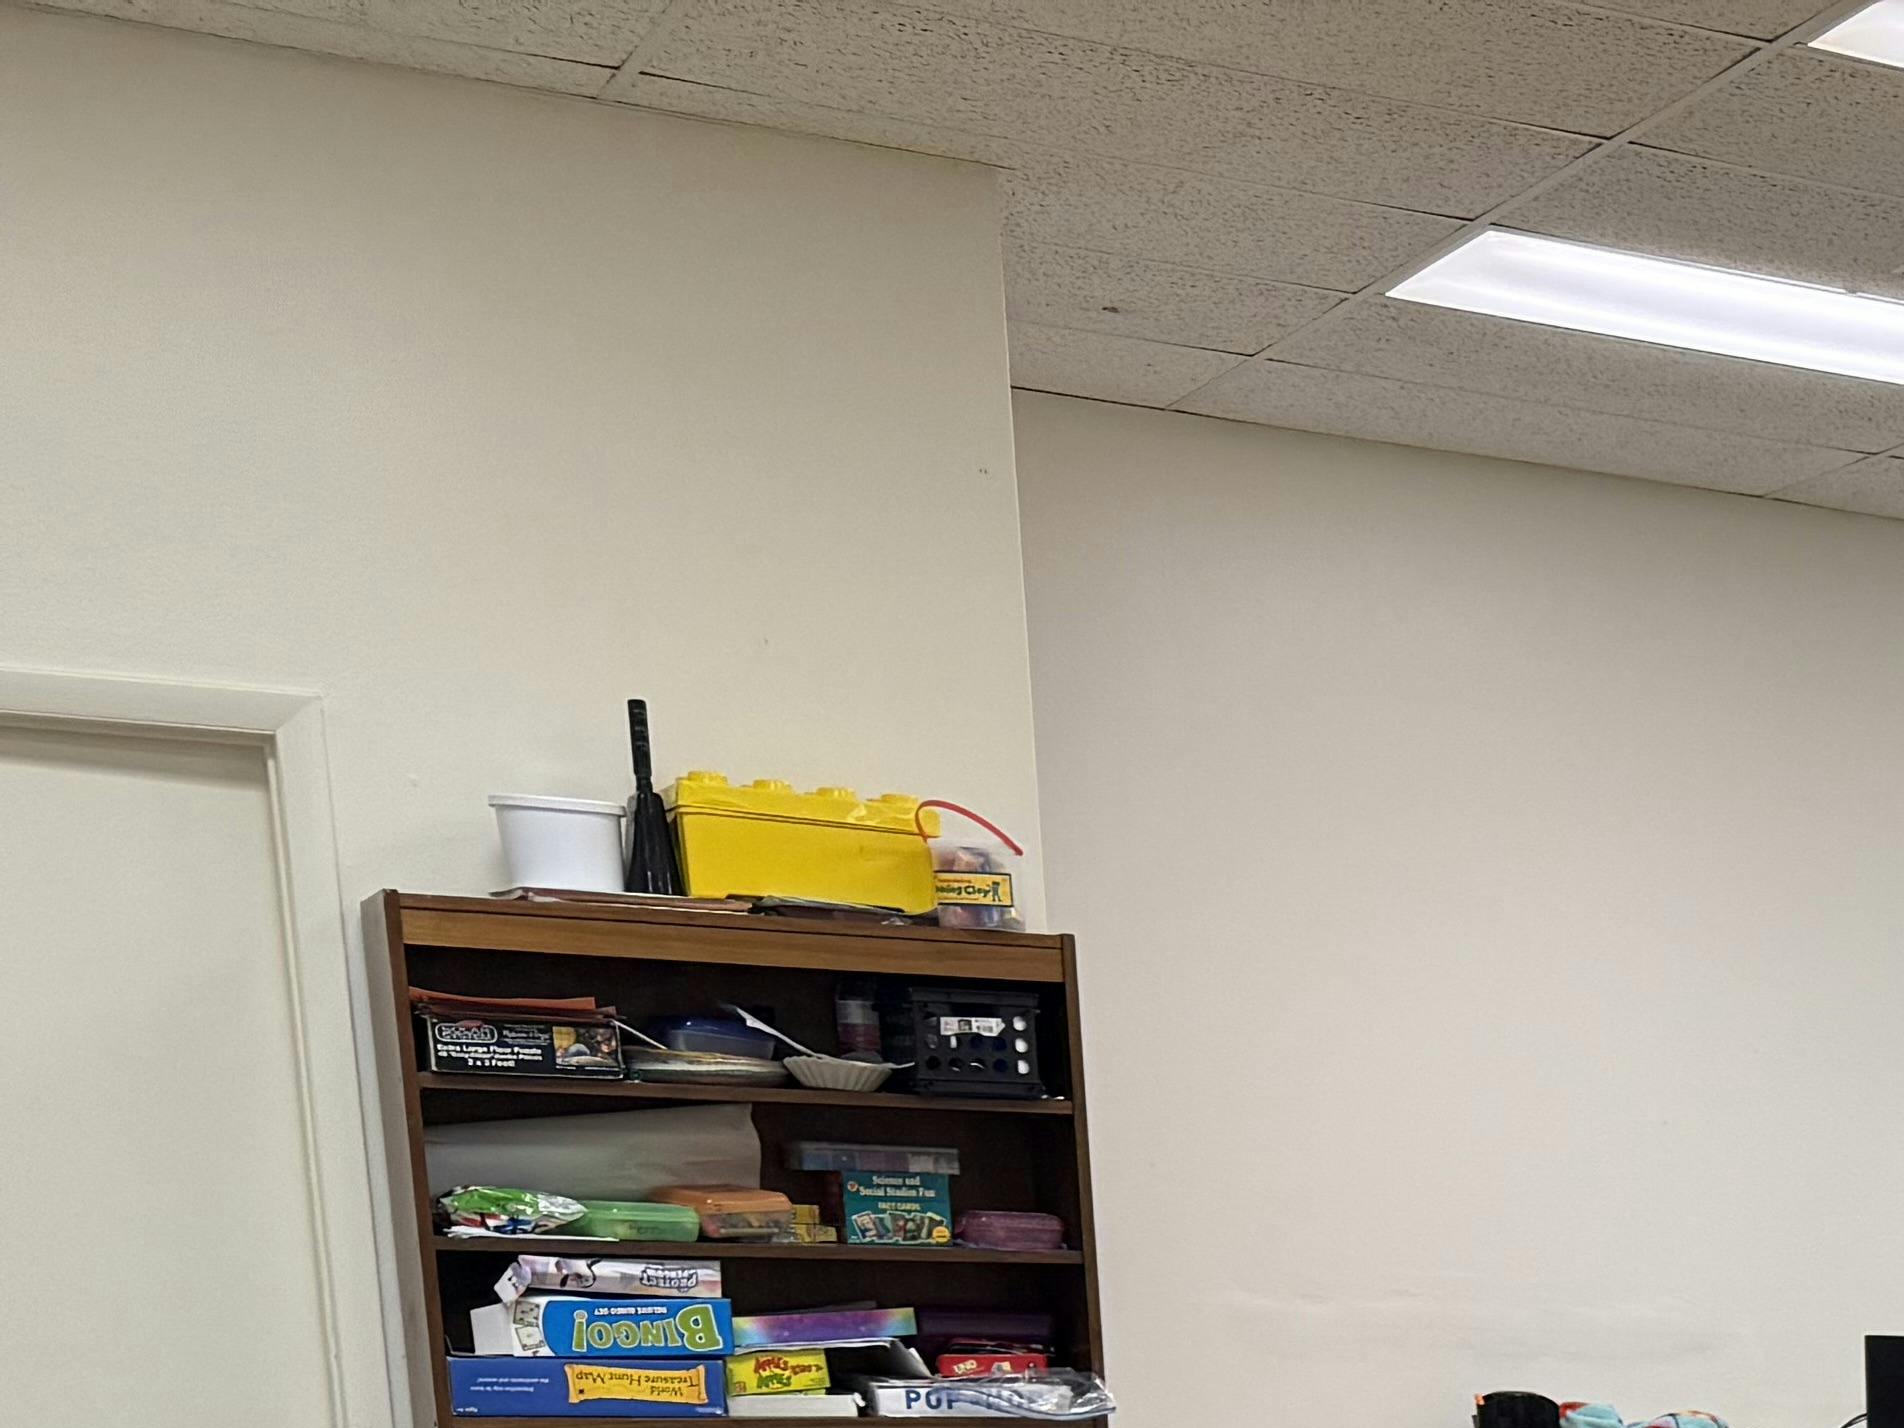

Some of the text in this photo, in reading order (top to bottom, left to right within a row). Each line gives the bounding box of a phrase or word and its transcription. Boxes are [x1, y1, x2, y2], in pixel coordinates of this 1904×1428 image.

[872, 1176, 920, 1186] Science and
[860, 1186, 936, 1198] Social Studies Fun
[878, 1202, 920, 1211] FACT CARDS
[641, 1273, 697, 1289] PROTECT
[572, 1304, 723, 1352] BINGO!
[575, 1370, 698, 1390] Treasure Hunt Map
[650, 1385, 684, 1397] World
